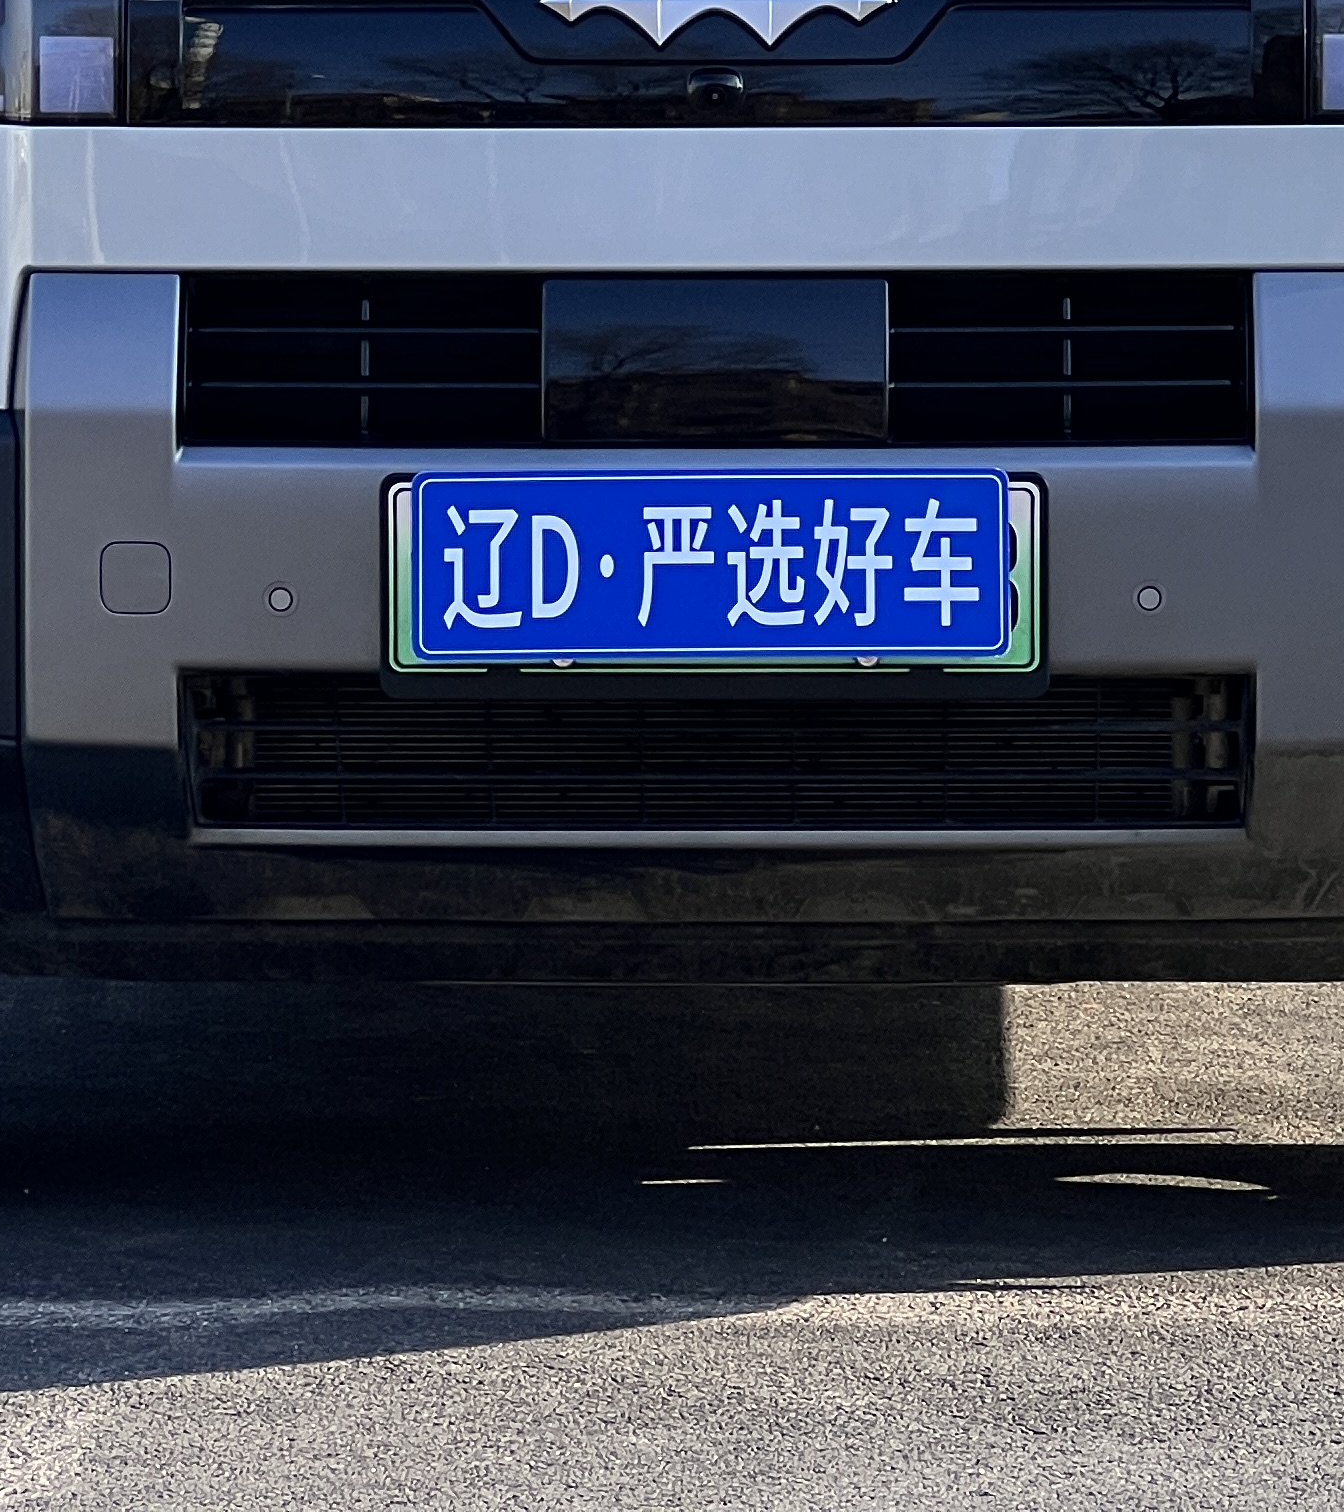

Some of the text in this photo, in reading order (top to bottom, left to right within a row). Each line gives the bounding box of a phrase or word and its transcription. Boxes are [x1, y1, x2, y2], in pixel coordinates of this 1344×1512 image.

[443, 497, 981, 629] 辽D·严选好车
